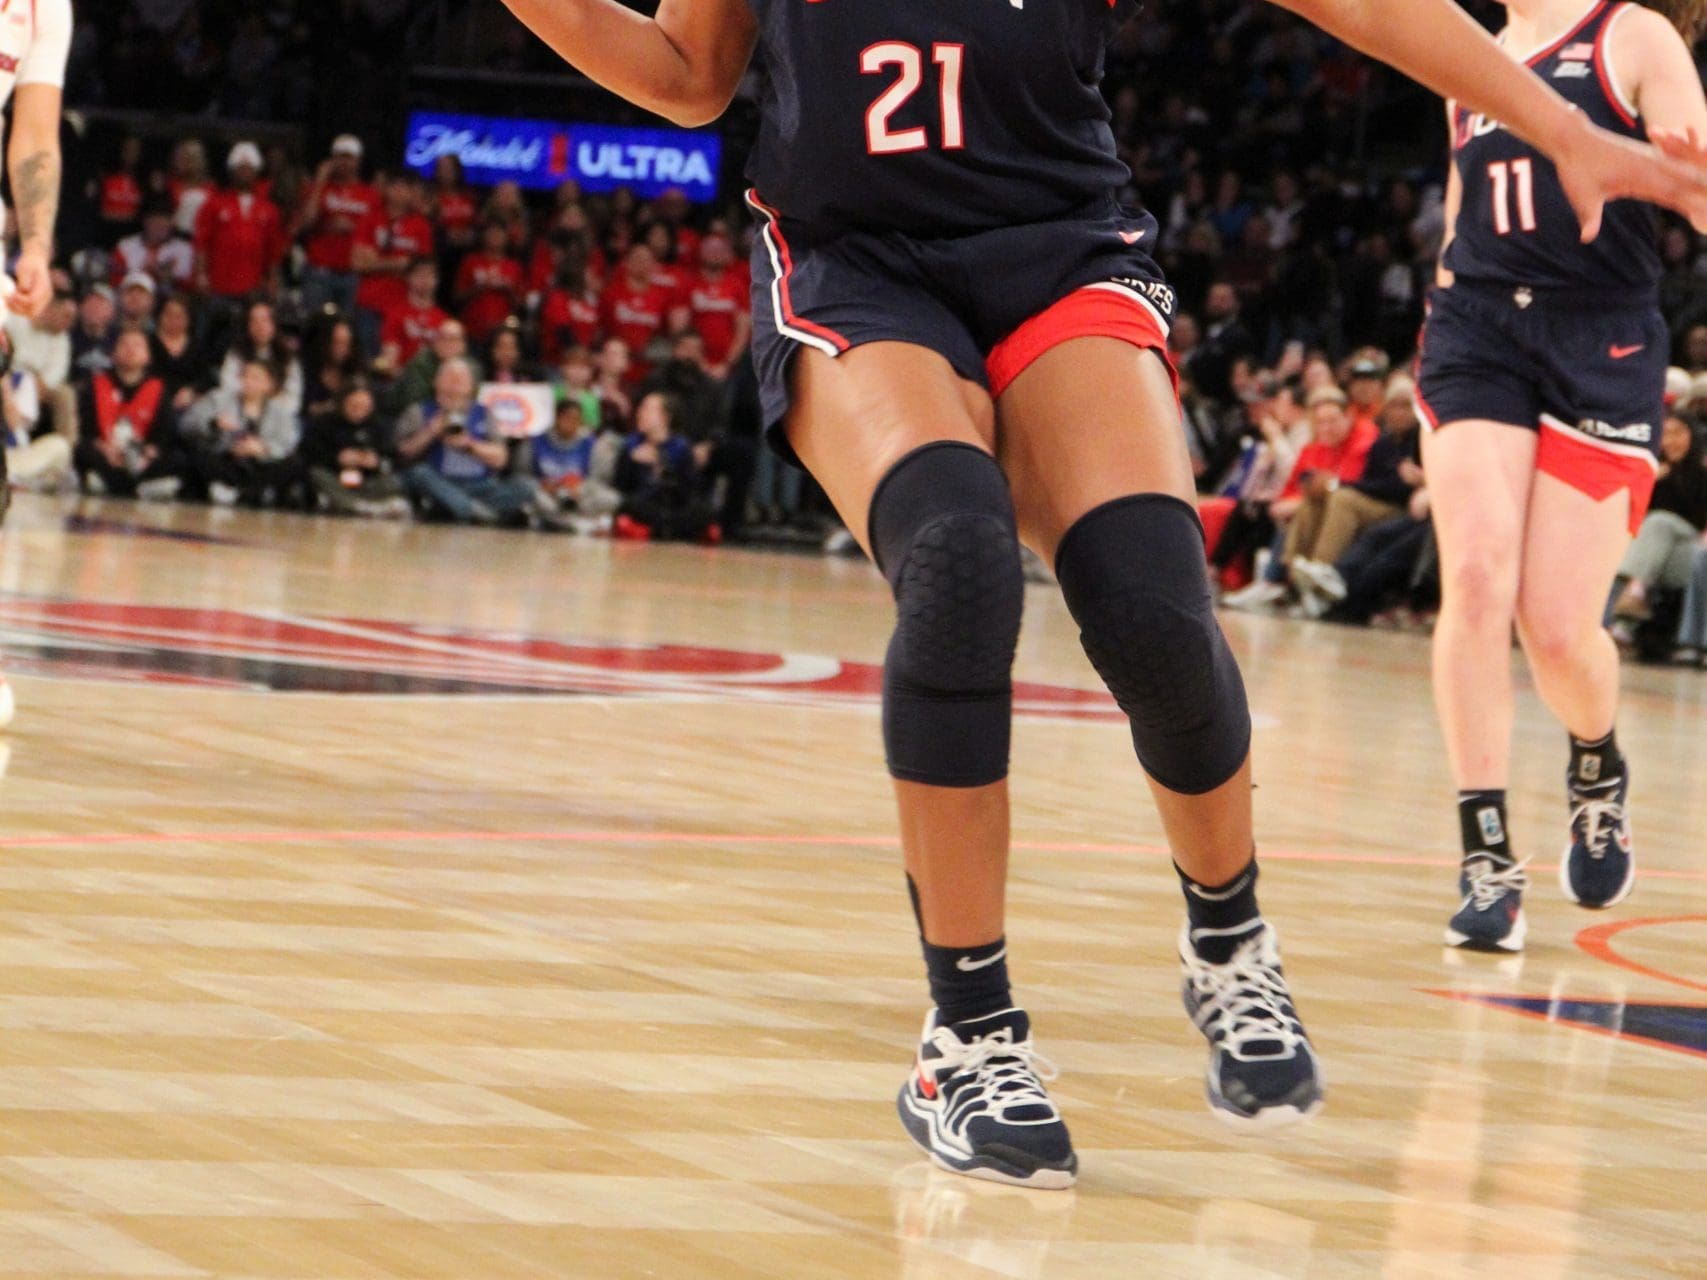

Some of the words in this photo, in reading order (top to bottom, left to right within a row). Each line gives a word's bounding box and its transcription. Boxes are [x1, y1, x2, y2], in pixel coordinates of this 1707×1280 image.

[859, 39, 966, 155] 21
[577, 140, 713, 185] ULTRA
[1488, 157, 1536, 237] 11
